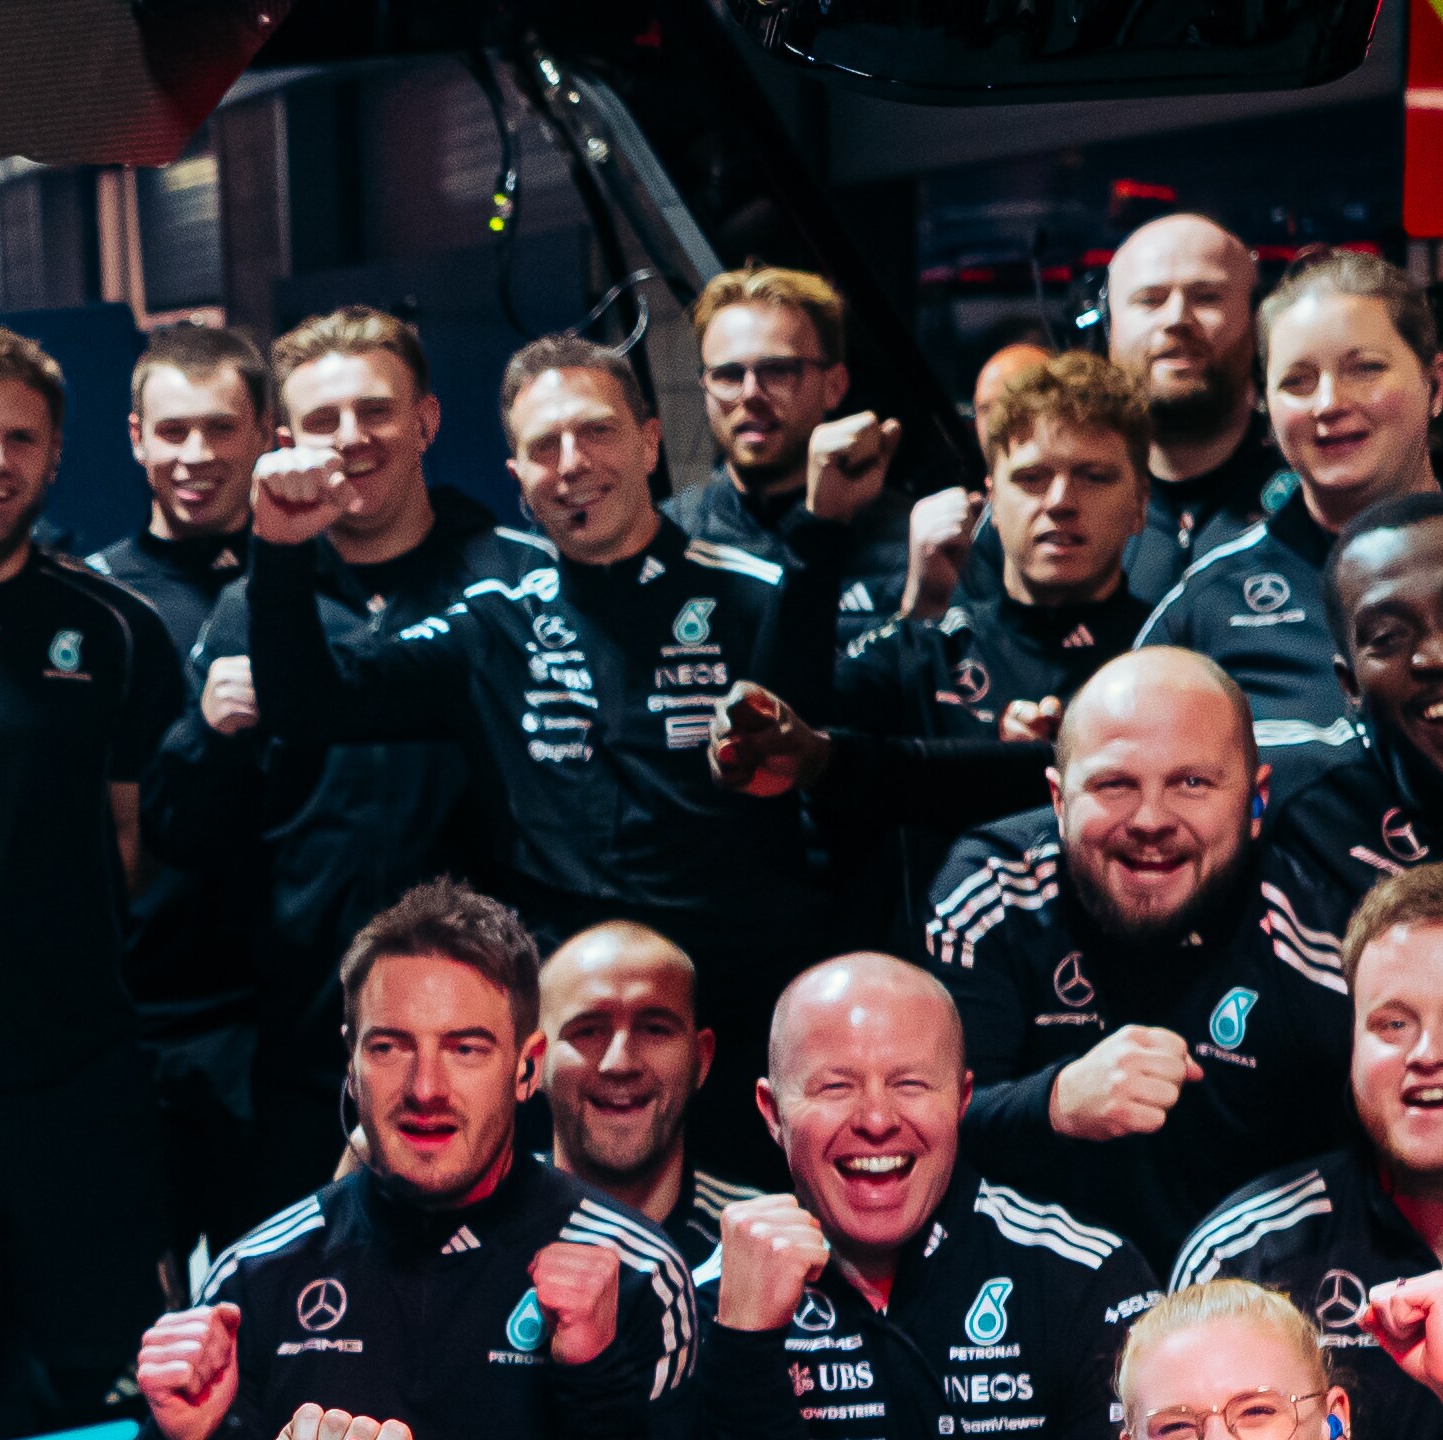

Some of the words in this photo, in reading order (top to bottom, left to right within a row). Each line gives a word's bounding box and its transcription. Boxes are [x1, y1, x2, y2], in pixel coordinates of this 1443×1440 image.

[949, 1343, 1020, 1361] PETRONAS
[818, 1361, 874, 1392] UBS
[944, 1373, 1033, 1403] INEOS
